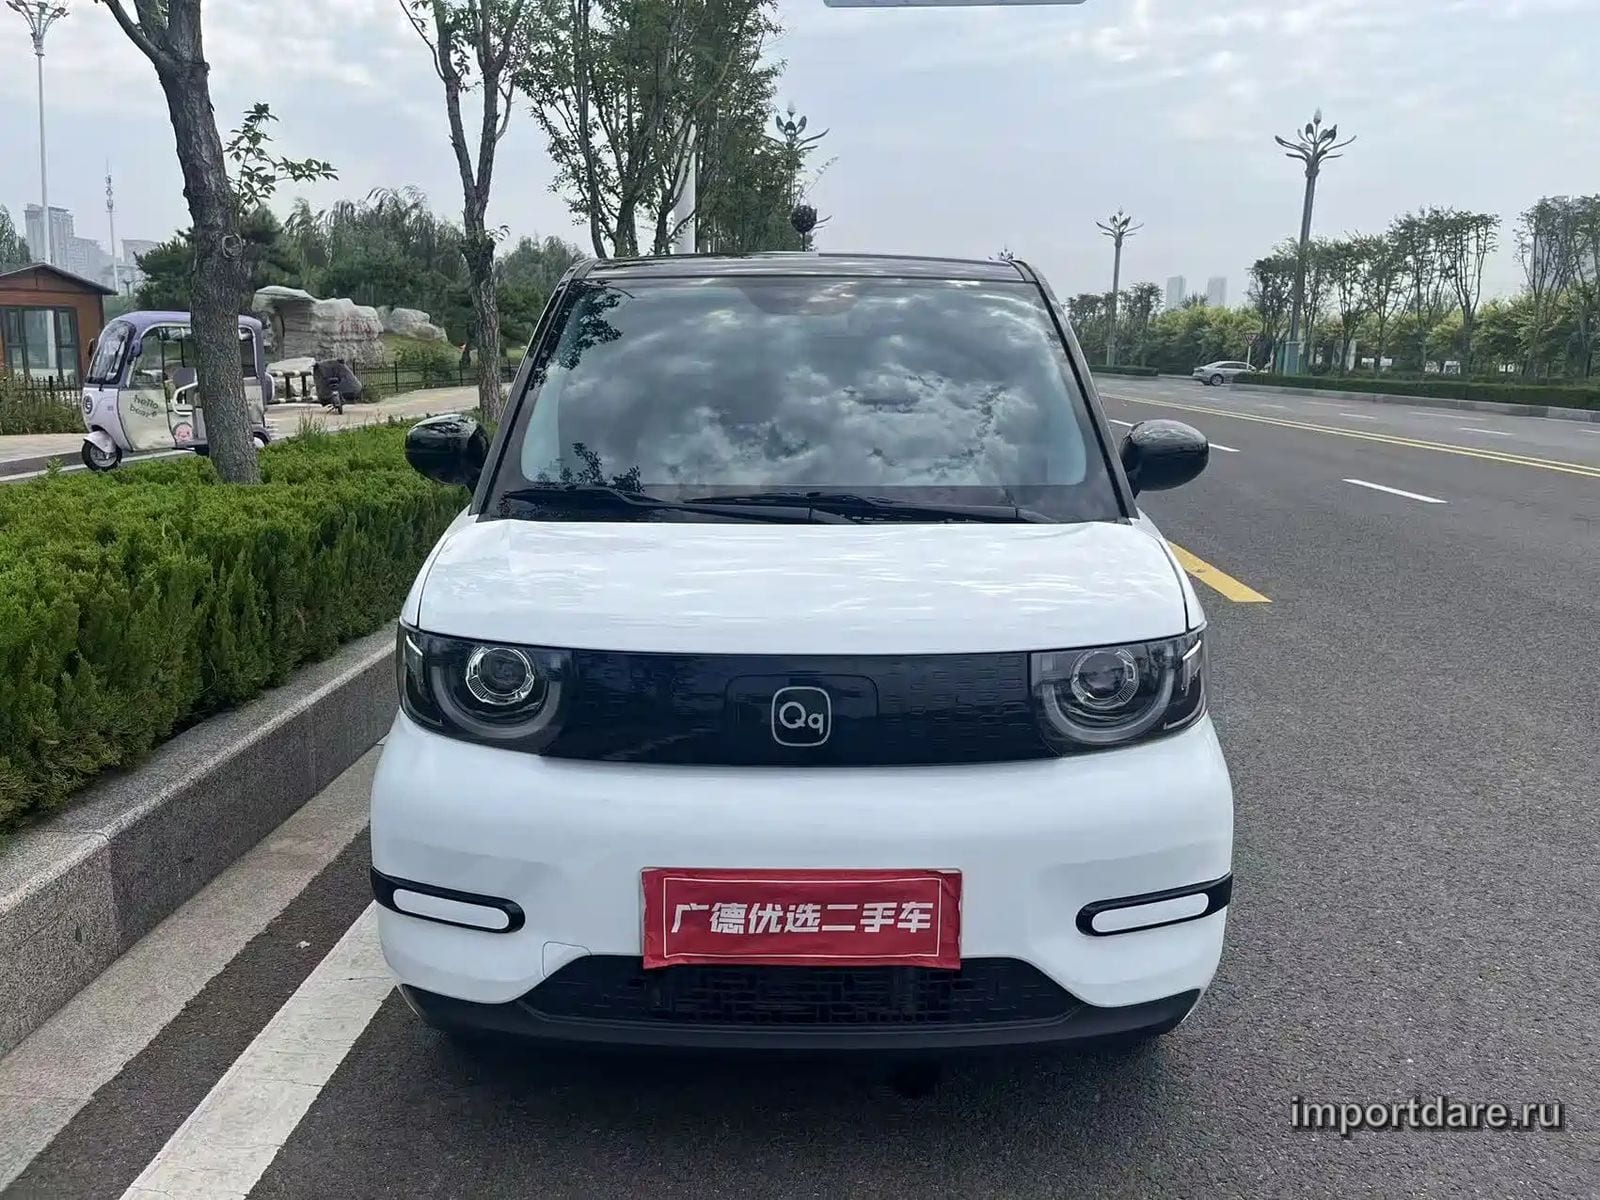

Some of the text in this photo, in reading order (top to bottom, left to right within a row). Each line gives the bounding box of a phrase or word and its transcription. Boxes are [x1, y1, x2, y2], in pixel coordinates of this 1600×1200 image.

[134, 394, 159, 409] hello
[671, 902, 934, 934] 广德优选二手车
